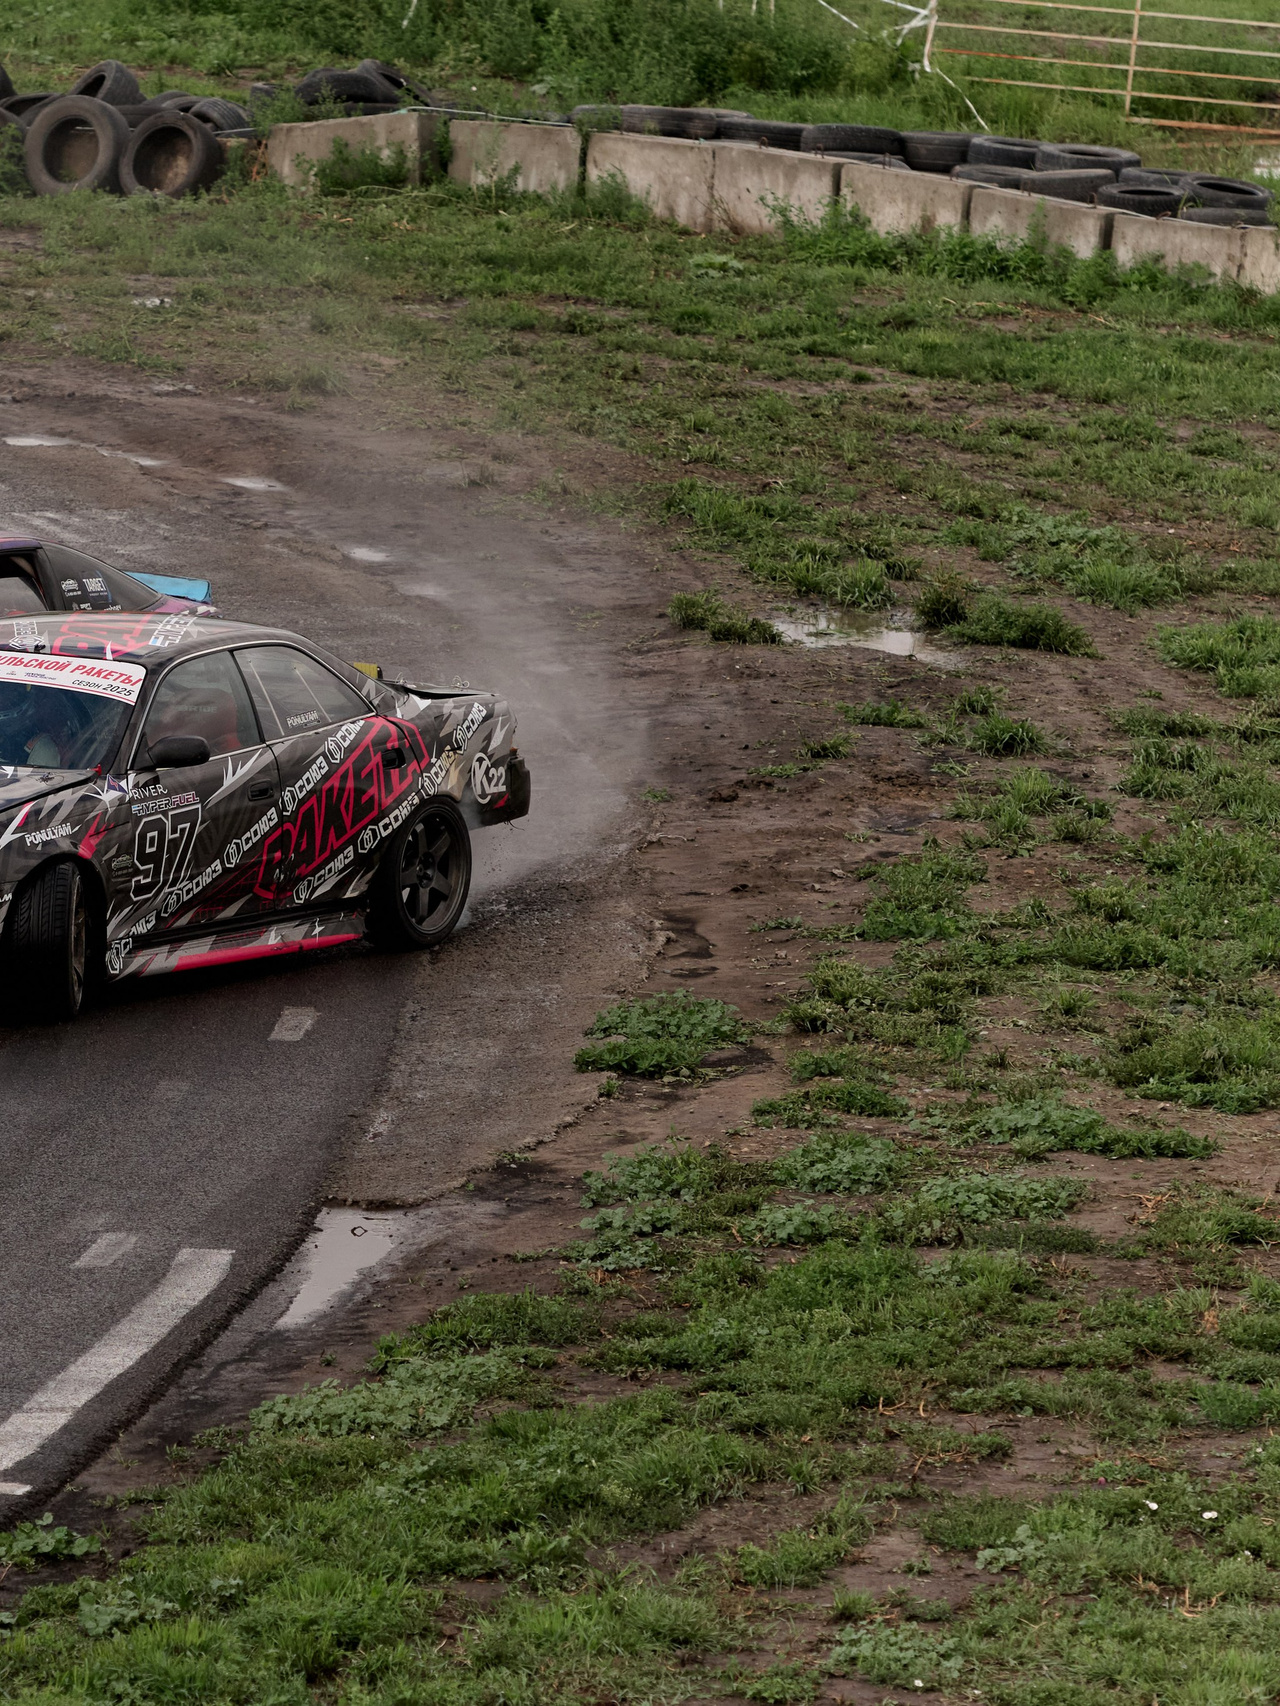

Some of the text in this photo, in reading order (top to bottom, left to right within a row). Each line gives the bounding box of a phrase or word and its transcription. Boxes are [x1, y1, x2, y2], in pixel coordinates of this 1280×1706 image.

[82, 577, 107, 592] TARGET
[71, 664, 144, 687] РАКЕТЫ
[72, 679, 136, 697] СЕЗОН 2025
[131, 784, 168, 800] RIVER
[294, 756, 330, 800] СОЮЗ
[25, 823, 72, 847] PONULYAM
[241, 807, 279, 852] СОЮЗ
[130, 803, 202, 902] 97
[314, 845, 354, 887] СОЮЗ
[183, 859, 223, 902] СОЮЗ
